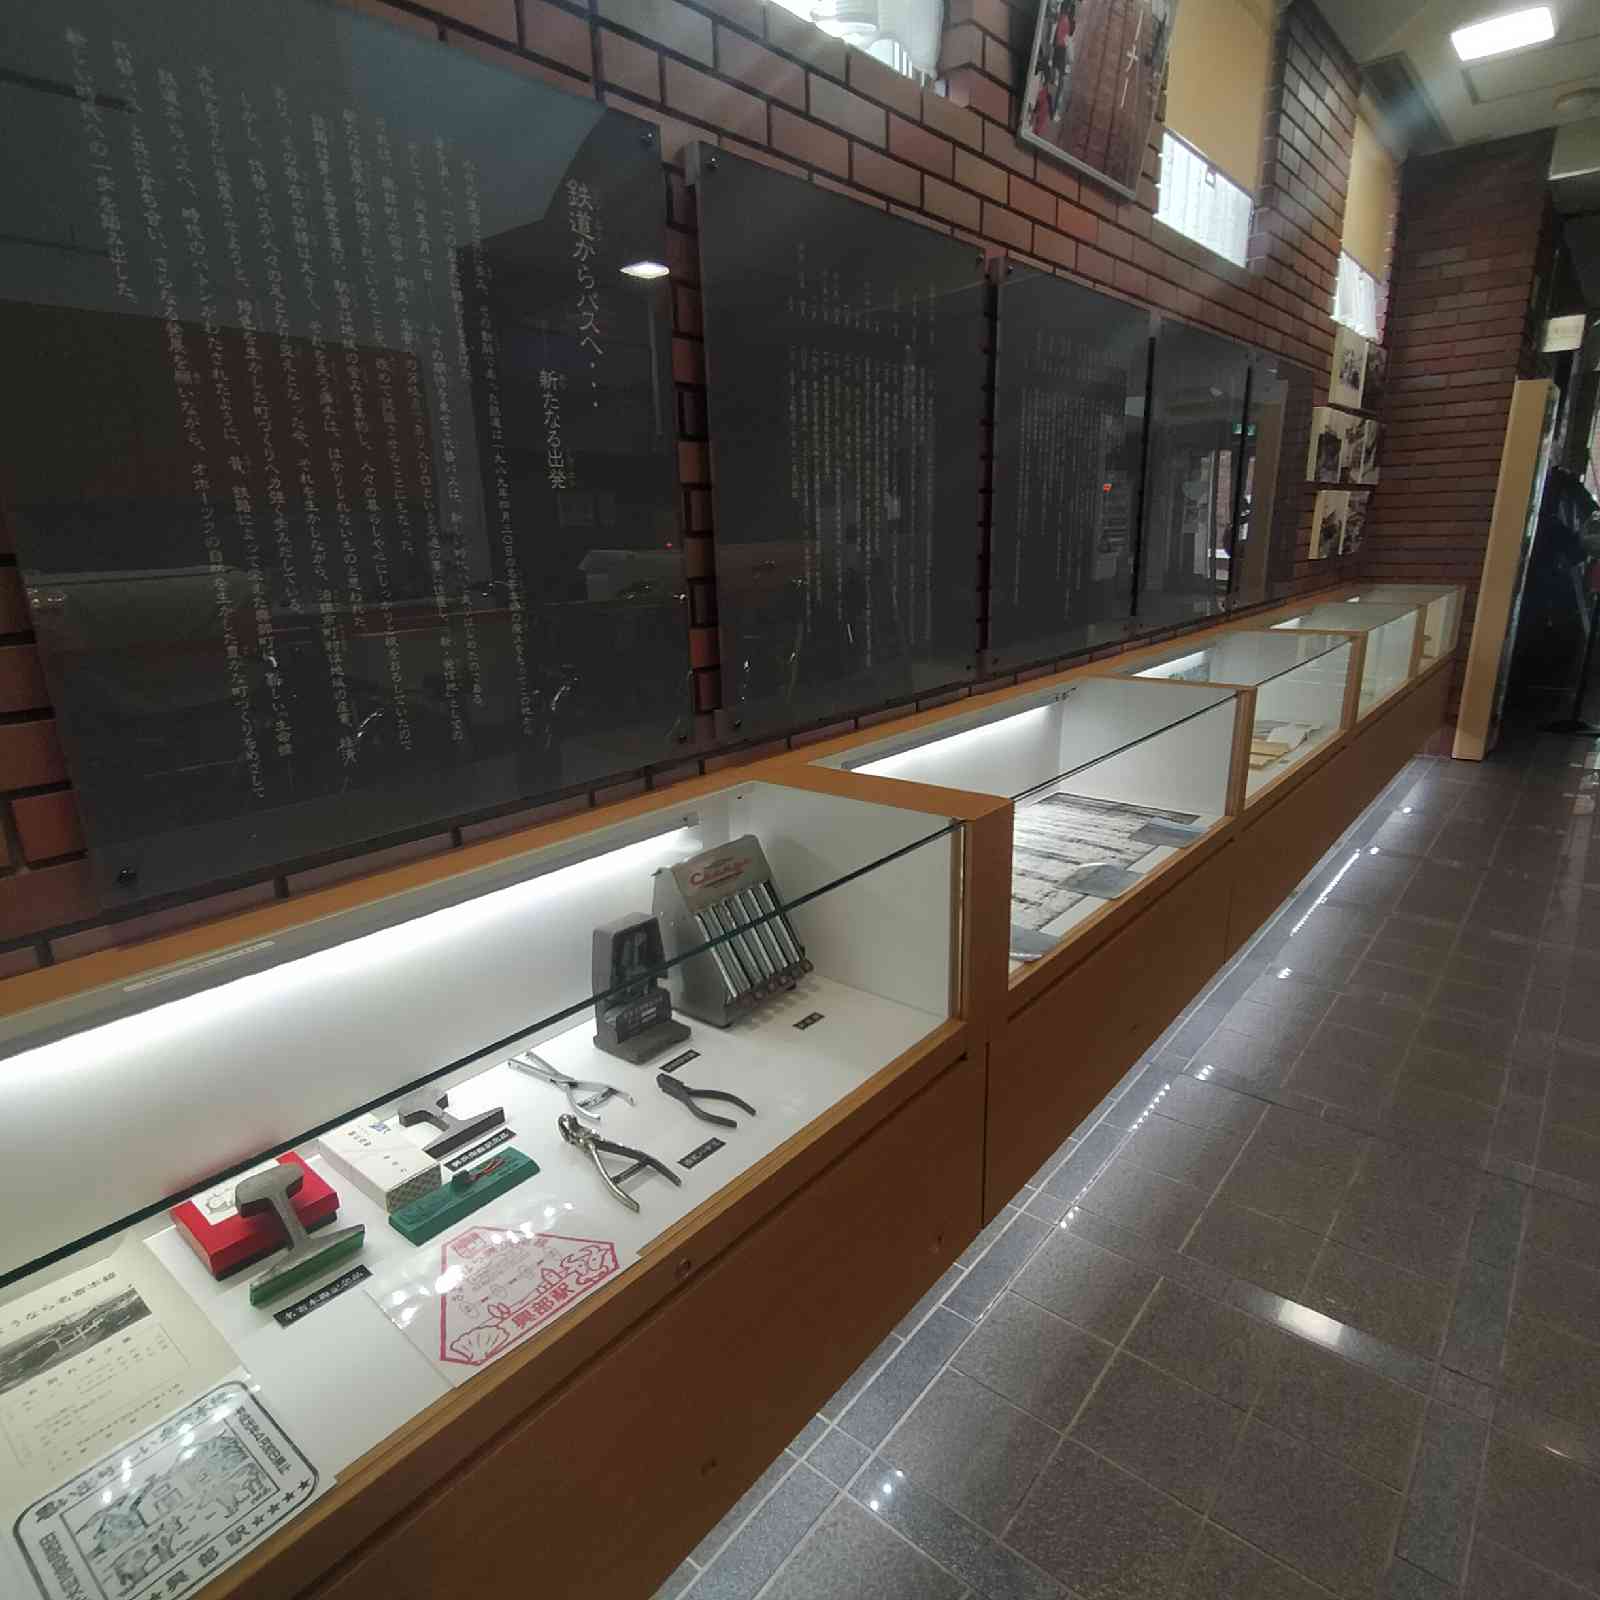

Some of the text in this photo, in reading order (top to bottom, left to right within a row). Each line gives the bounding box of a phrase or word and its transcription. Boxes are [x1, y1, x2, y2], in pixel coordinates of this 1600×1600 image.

[538, 369, 567, 490] 新たなる出発
[512, 1282, 575, 1330] 興部駅
